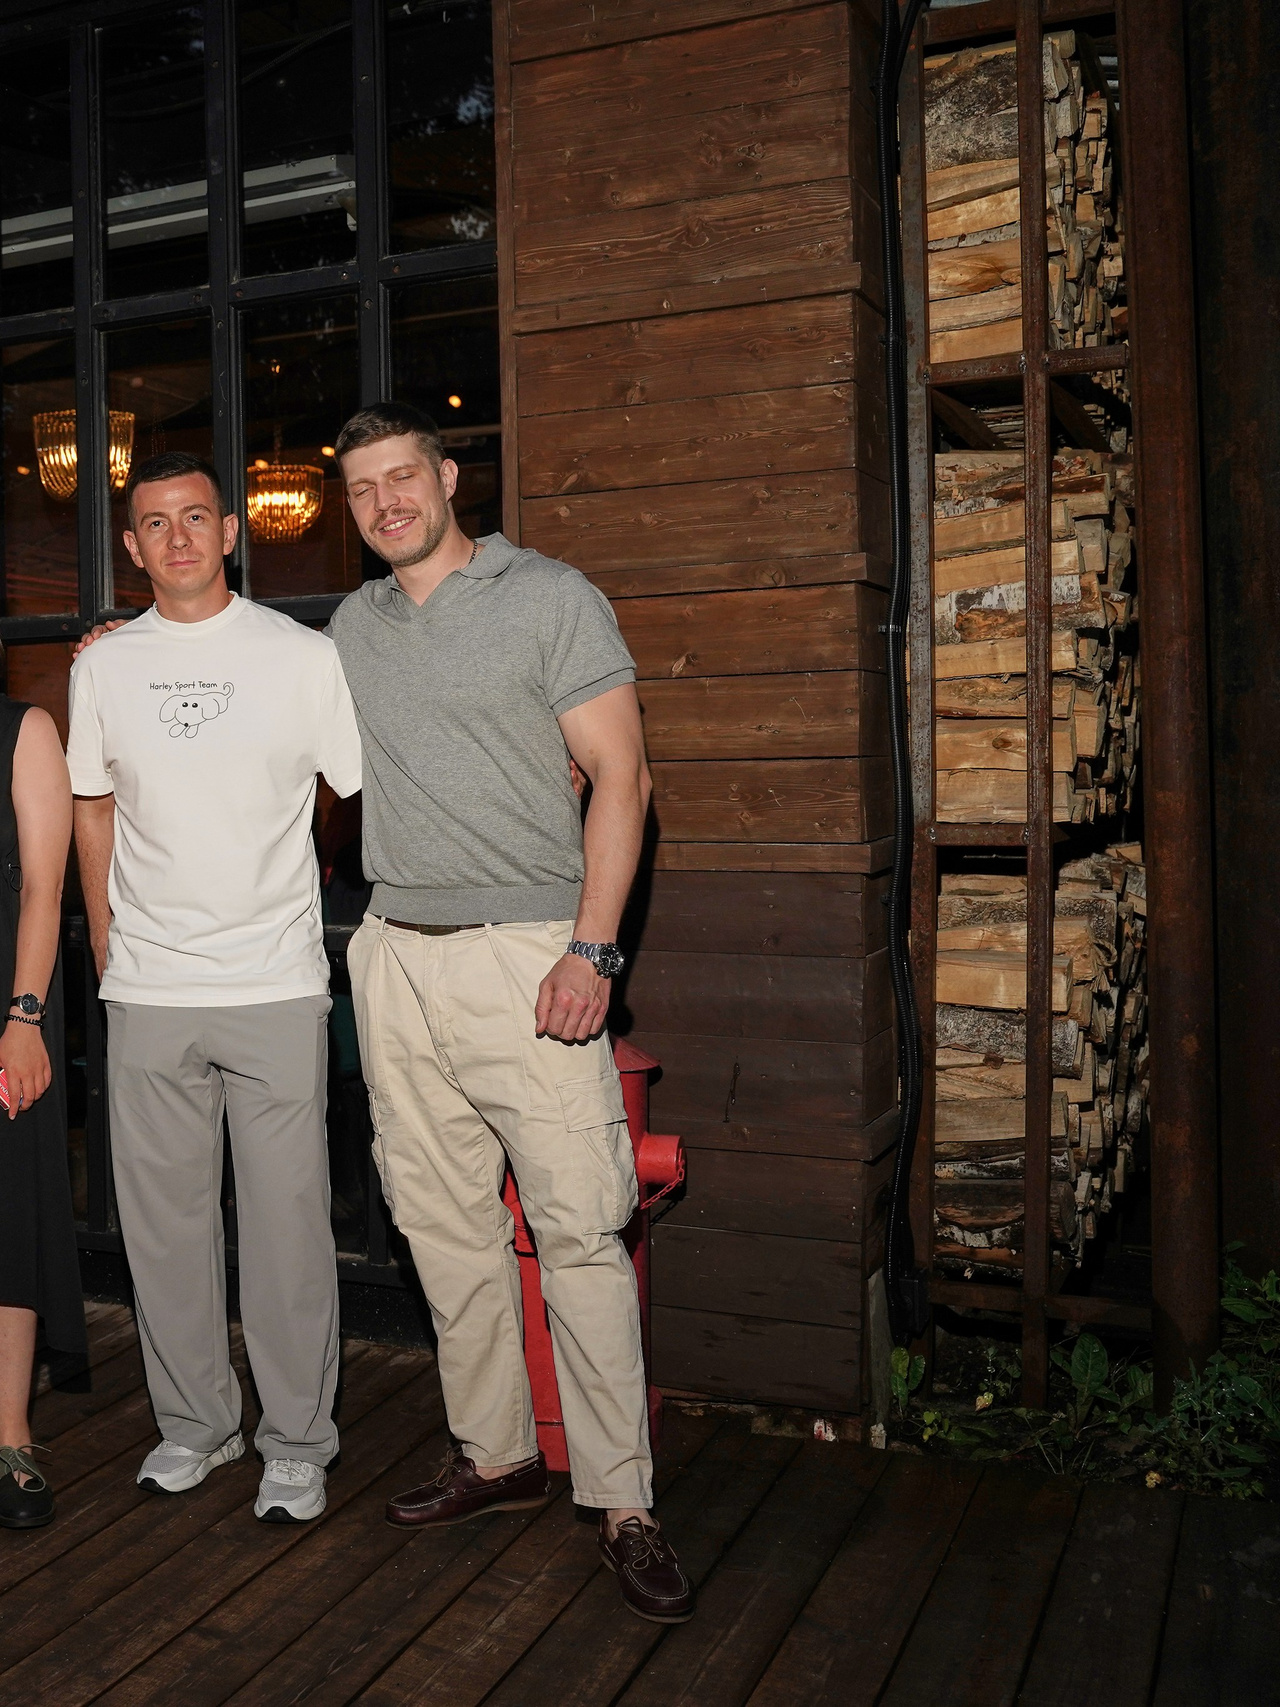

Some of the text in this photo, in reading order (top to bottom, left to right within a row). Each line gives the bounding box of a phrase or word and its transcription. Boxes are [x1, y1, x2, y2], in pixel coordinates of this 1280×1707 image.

[149, 681, 218, 691] Harley Sport Team
